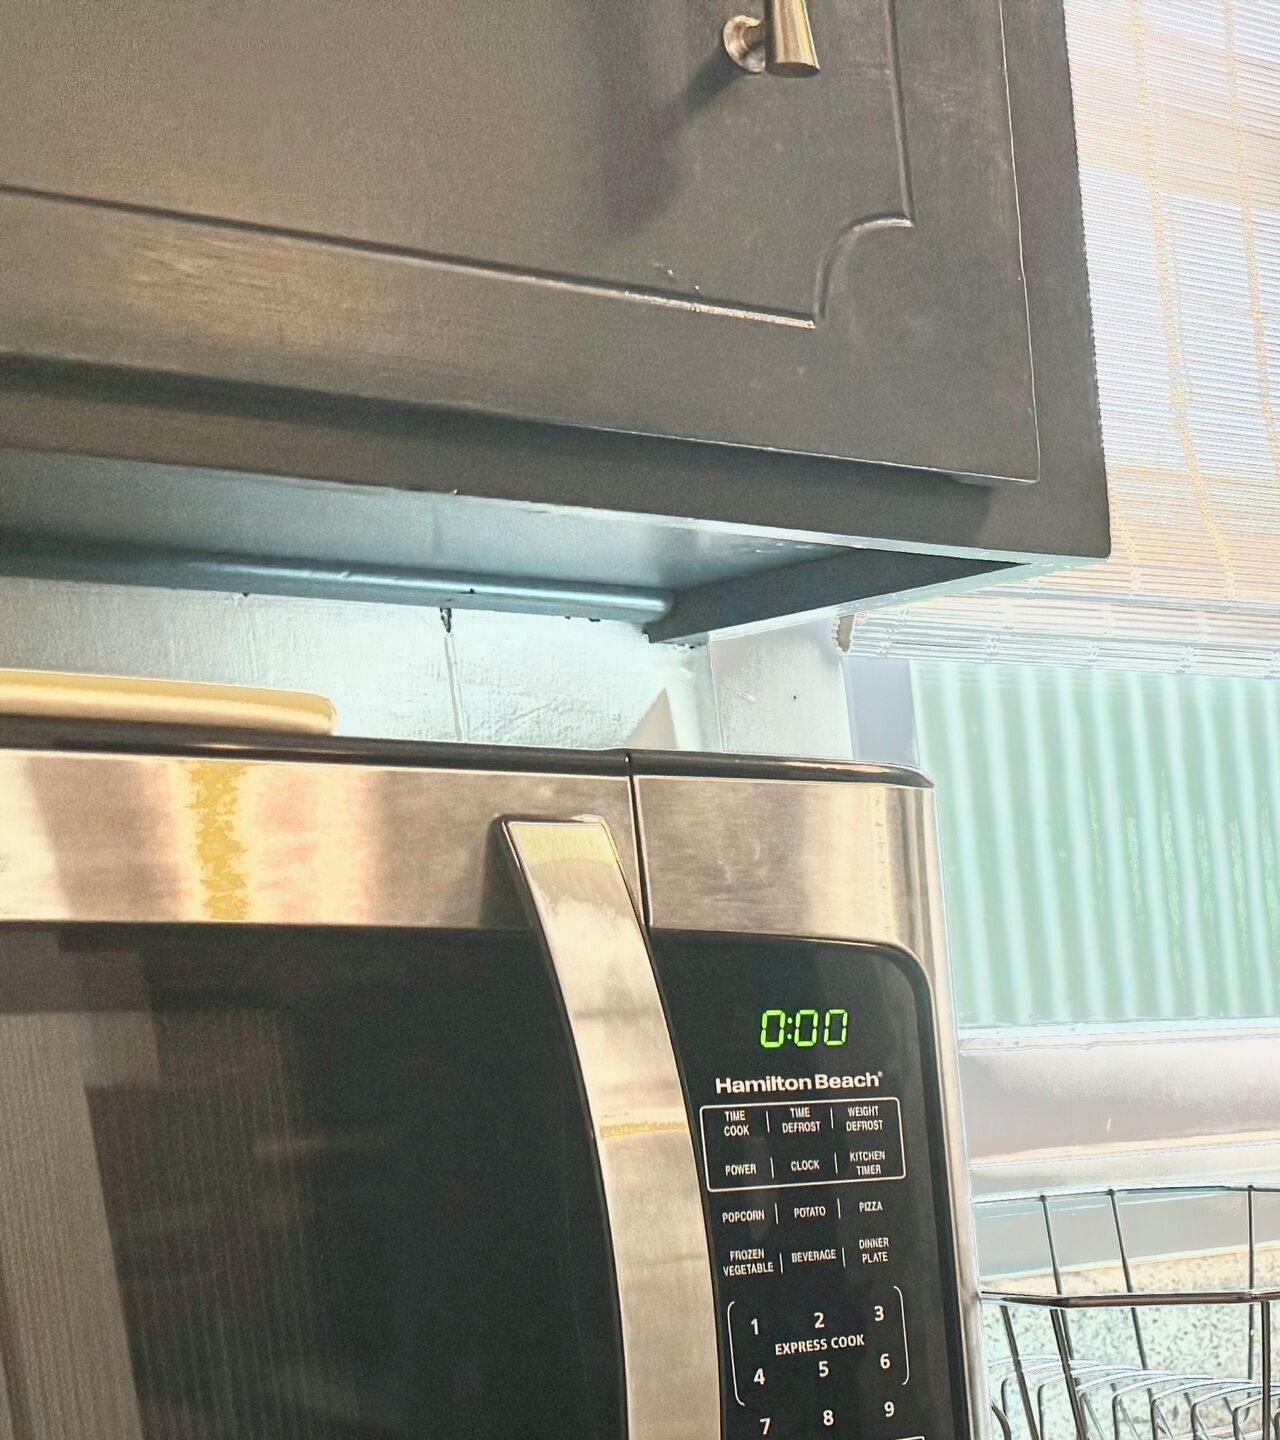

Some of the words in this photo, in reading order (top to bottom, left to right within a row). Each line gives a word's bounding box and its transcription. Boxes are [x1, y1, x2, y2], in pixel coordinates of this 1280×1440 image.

[761, 1009, 847, 1048] 0:00
[716, 1076, 812, 1093] Hamilton
[725, 1110, 745, 1121] TIME
[790, 1107, 810, 1118] TIME
[848, 1106, 878, 1117] WEIGHT
[724, 1125, 749, 1136] COOK
[782, 1121, 820, 1133] DEFROST
[846, 1120, 883, 1131] DEFROST
[850, 1151, 885, 1162] KITCHEN
[726, 1164, 756, 1175] POWER
[791, 1160, 819, 1171] CLOCK
[856, 1164, 881, 1175] TIMER
[794, 1206, 826, 1218] POTATO
[859, 1201, 883, 1212] PIZZA
[723, 1210, 764, 1222] POPCORN
[859, 1238, 889, 1249] DINNER
[730, 1248, 764, 1261] FROZEN
[792, 1249, 836, 1262] BEVERAGE
[862, 1252, 888, 1263] PLATE
[723, 1262, 773, 1276] VEGETABLE
[875, 1306, 884, 1321] 3
[814, 1312, 824, 1328] 2
[751, 1319, 758, 1335] 1
[775, 1339, 827, 1355] EXPRESS
[831, 1334, 864, 1348] COOK
[880, 1353, 890, 1369] 6
[819, 1361, 828, 1377] 5
[754, 1369, 765, 1384] 4
[884, 1402, 894, 1417] 9
[823, 1410, 834, 1425] 8
[760, 1418, 770, 1434] 7
